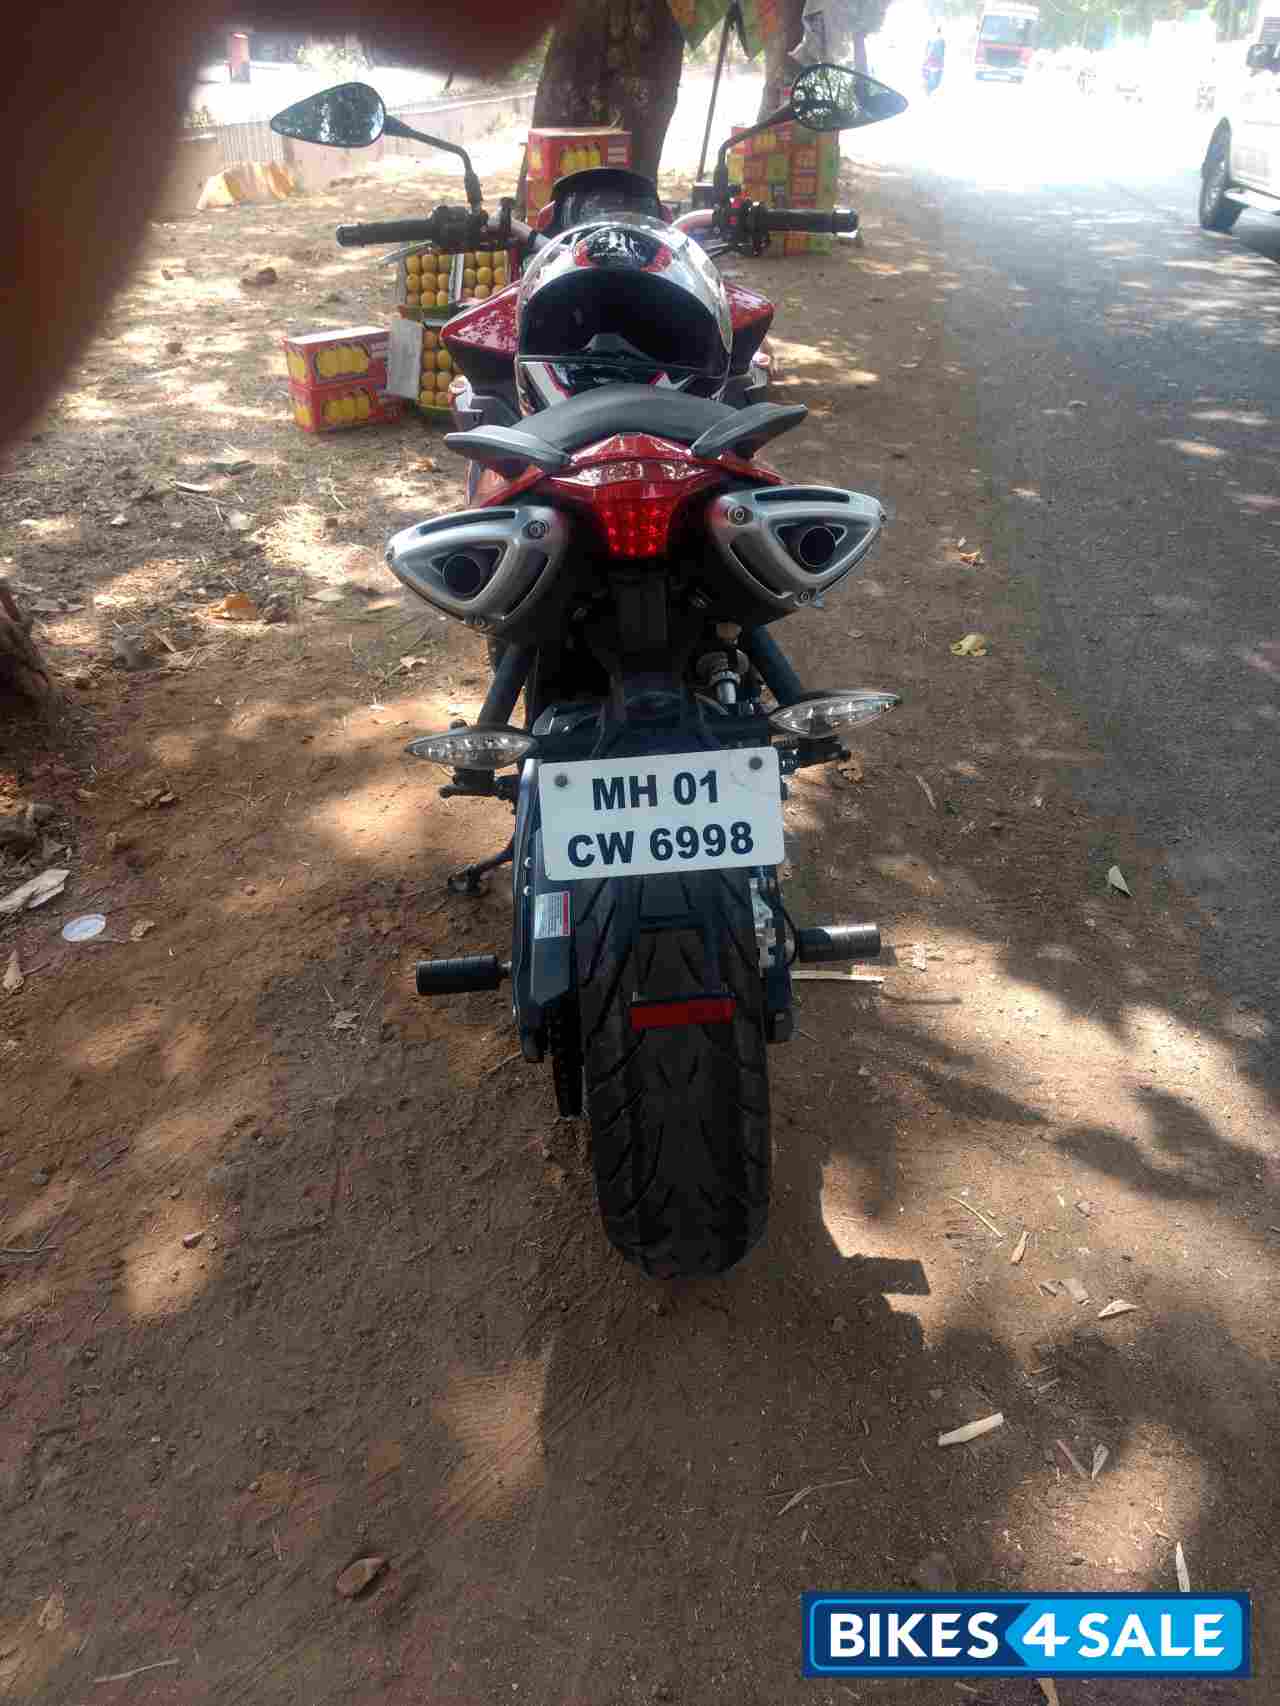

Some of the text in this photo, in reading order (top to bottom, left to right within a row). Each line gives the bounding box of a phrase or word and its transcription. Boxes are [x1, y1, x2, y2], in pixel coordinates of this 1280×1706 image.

[592, 769, 719, 811] MH 01
[567, 821, 754, 868] CW 6998
